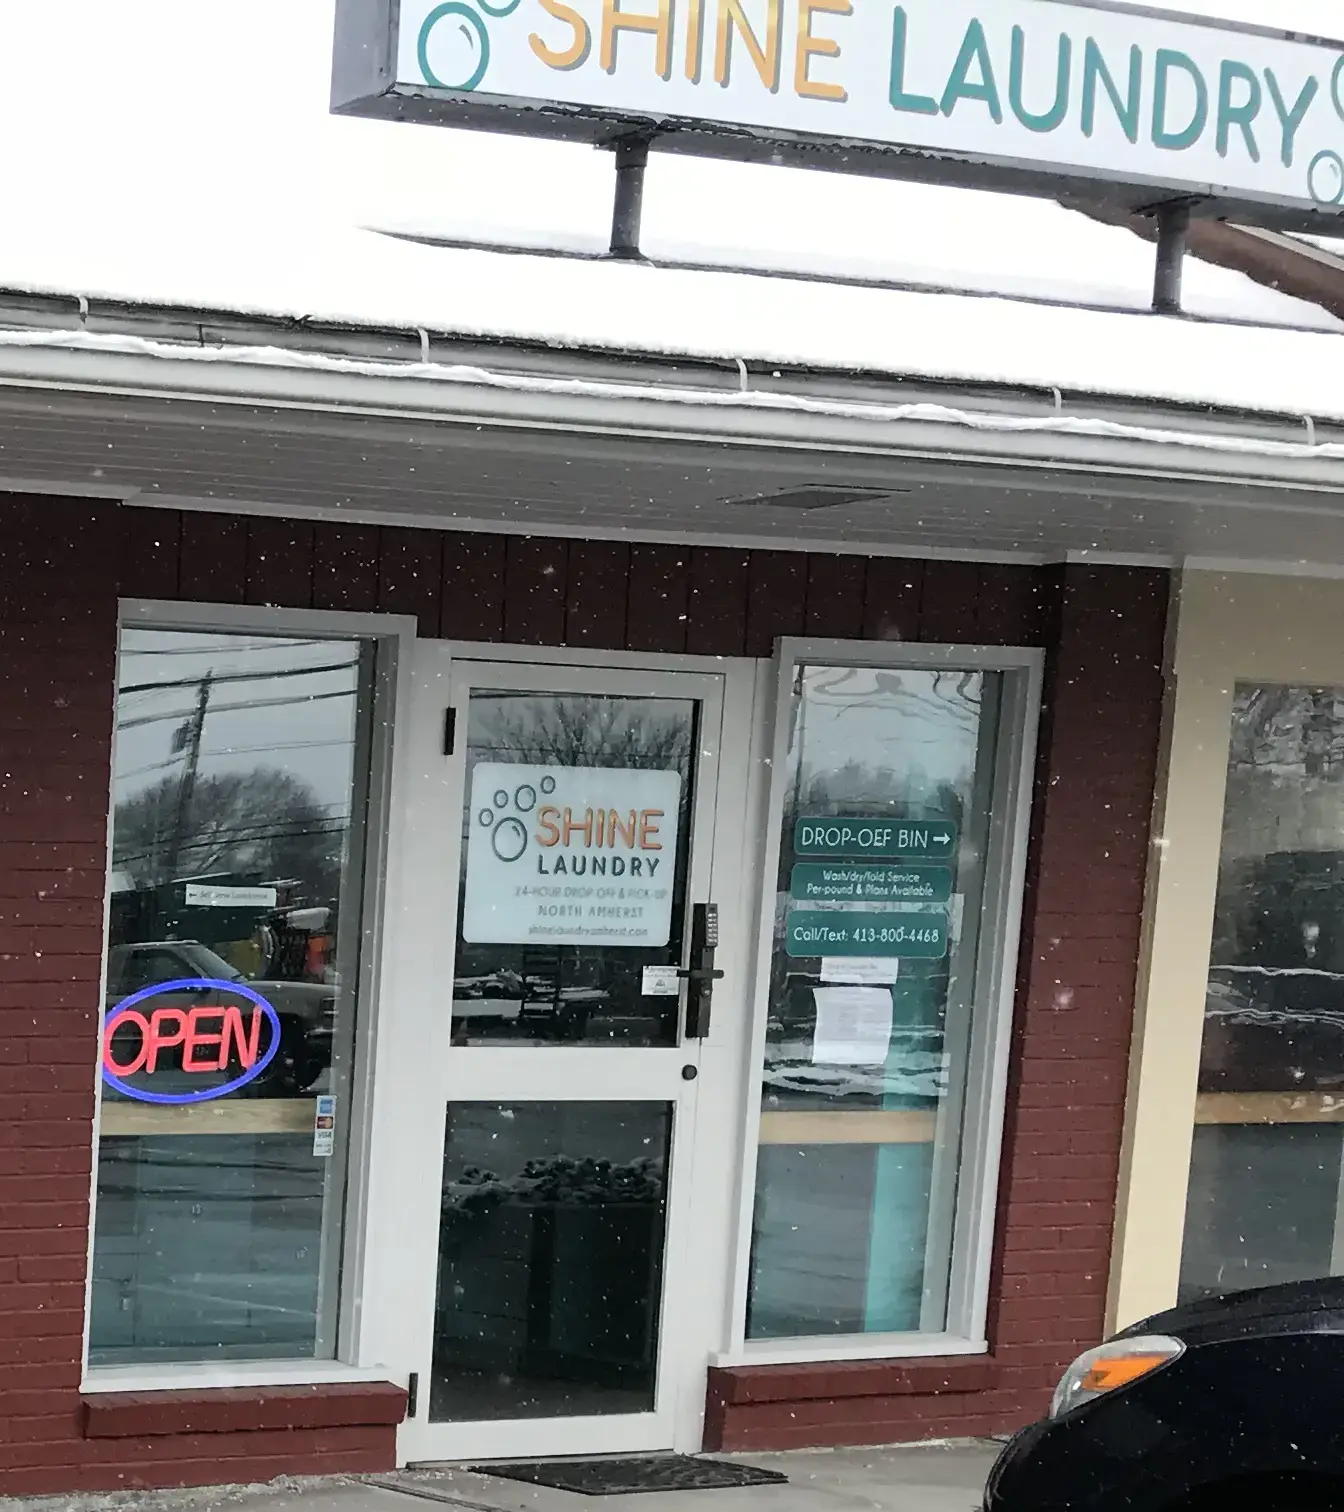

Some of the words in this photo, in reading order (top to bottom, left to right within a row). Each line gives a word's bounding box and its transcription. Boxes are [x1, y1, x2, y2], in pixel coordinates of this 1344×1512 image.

[528, 0, 853, 103] SHINE
[889, 5, 1320, 168] LAUNDRY
[536, 805, 665, 850] SHINE
[898, 829, 929, 849] BIN
[537, 855, 660, 877] LAUNDRY
[887, 871, 921, 883] Service
[806, 882, 854, 896] Per-pound
[855, 883, 863, 895] &
[865, 884, 889, 896] Plans
[890, 885, 934, 897] Available
[538, 905, 582, 917] NORTH
[588, 906, 644, 919] AMHERST
[793, 926, 849, 942] Call/Text:
[852, 926, 940, 943] 413-800-4468
[103, 1003, 263, 1076] OPEN
